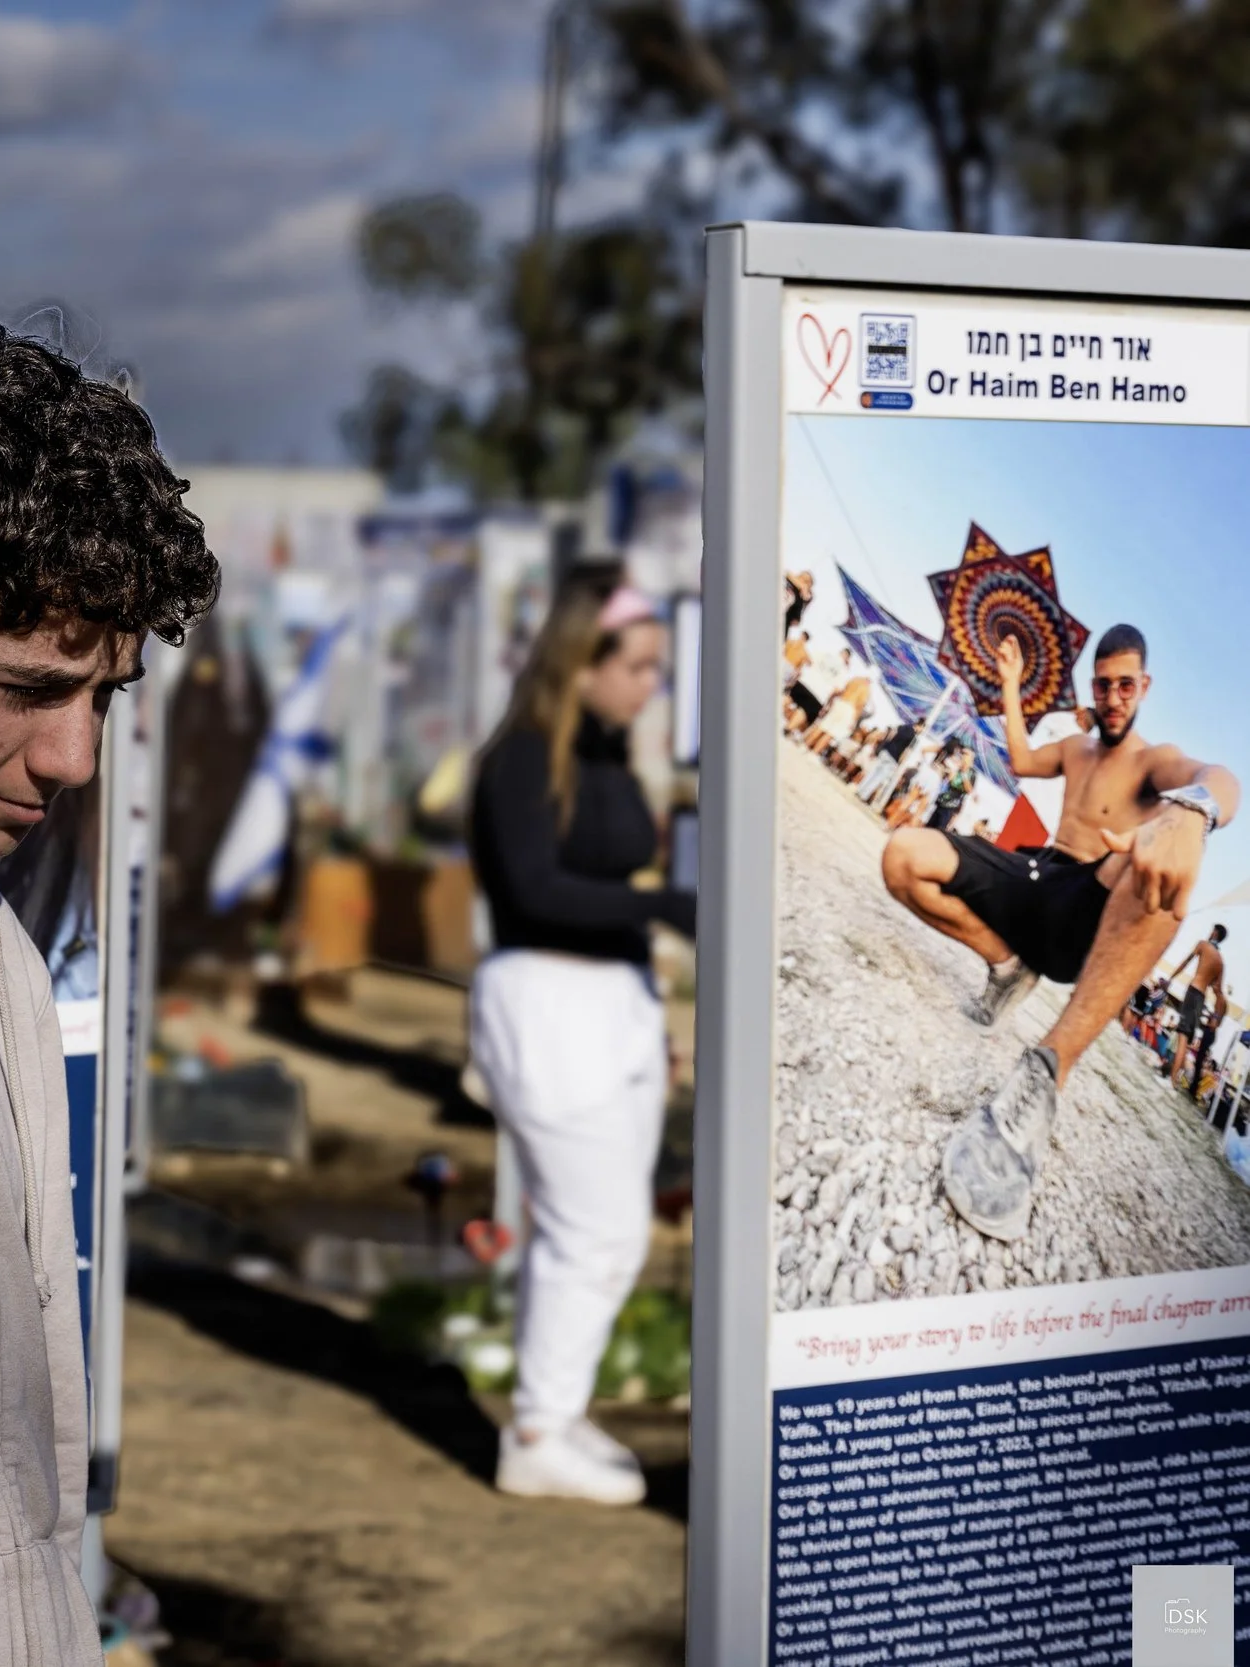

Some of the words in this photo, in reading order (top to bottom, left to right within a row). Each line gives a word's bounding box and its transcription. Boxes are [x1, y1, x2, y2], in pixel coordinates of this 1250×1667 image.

[968, 331, 1008, 355] חמו
[1020, 333, 1042, 361] בן
[1053, 335, 1101, 359] חיים
[1113, 337, 1150, 360] אור
[928, 370, 958, 395] Or
[970, 372, 1038, 397] Haim
[1051, 374, 1099, 400] Ben
[1112, 377, 1186, 403] Hamo
[866, 1333, 911, 1364] your
[917, 1327, 962, 1355] story
[967, 1323, 985, 1342] to
[991, 1309, 1018, 1350] life
[1023, 1306, 1073, 1346] before
[1080, 1301, 1104, 1329] the
[1103, 1295, 1151, 1338] final
[1153, 1293, 1217, 1329] chapter
[780, 1406, 801, 1420] He
[803, 1404, 833, 1418] was
[836, 1398, 854, 1414] 19
[856, 1397, 896, 1415] years
[898, 1391, 920, 1407] old
[922, 1390, 956, 1404] from
[958, 1382, 1017, 1400] Rehovot,
[1019, 1379, 1042, 1392] the
[1044, 1371, 1095, 1389] beloved
[1097, 1365, 1155, 1386] youngest
[1158, 1364, 1181, 1375] son
[1184, 1359, 1197, 1372] of
[779, 1441, 833, 1460] Rachel.
[835, 1438, 847, 1453] A
[849, 1436, 892, 1455] young
[894, 1429, 933, 1446] uncle
[935, 1426, 965, 1441] who
[967, 1418, 1015, 1437] adored
[1017, 1417, 1038, 1430] his
[1040, 1413, 1084, 1428] nieces
[1086, 1407, 1111, 1422] and
[1113, 1402, 1173, 1419] nephews.
[779, 1465, 797, 1480] Or
[799, 1463, 829, 1477] was
[832, 1452, 899, 1473] murdered
[902, 1452, 920, 1464] on
[922, 1444, 978, 1462] October
[980, 1440, 994, 1456] 7,
[996, 1436, 1034, 1452] 2023,
[1036, 1434, 1050, 1447] at
[1053, 1432, 1075, 1445] the
[1138, 1420, 1175, 1434] Curve
[1178, 1414, 1212, 1428] while
[824, 1420, 852, 1435] The
[854, 1414, 907, 1432] brother
[908, 1410, 924, 1425] of
[778, 1482, 830, 1500] escape
[833, 1476, 865, 1492] with
[867, 1473, 889, 1488] his
[891, 1467, 940, 1485] friends
[942, 1464, 974, 1478] from
[977, 1460, 1000, 1474] the
[1003, 1457, 1037, 1470] Nova
[1039, 1448, 1091, 1466] festival.
[778, 1504, 805, 1519] Our
[807, 1500, 826, 1515] Or
[828, 1498, 857, 1512] was
[860, 1496, 878, 1508] an
[961, 1484, 971, 1495] a
[973, 1480, 1001, 1494] free
[1004, 1474, 1042, 1492] spirit.
[1046, 1470, 1064, 1484] He
[1066, 1464, 1101, 1480] loved
[1104, 1464, 1118, 1476] to
[1163, 1454, 1188, 1467] ride
[1191, 1452, 1210, 1463] his
[778, 1522, 805, 1539] and
[808, 1520, 827, 1535] sit
[830, 1518, 844, 1532] in
[846, 1516, 876, 1530] awe
[878, 1510, 894, 1525] of
[896, 1506, 950, 1523] endless
[953, 1496, 1030, 1515] landscapes
[1032, 1491, 1063, 1504] from
[1065, 1482, 1114, 1500] lookout
[1116, 1478, 1156, 1496] points
[1158, 1472, 1200, 1487] across
[1203, 1468, 1224, 1480] the
[777, 1561, 810, 1578] With
[813, 1560, 832, 1573] an
[834, 1555, 869, 1572] open
[872, 1548, 914, 1565] heart,
[916, 1546, 934, 1558] he
[937, 1536, 997, 1556] dreamed
[1000, 1532, 1014, 1547] of
[1017, 1534, 1026, 1544] a
[1028, 1529, 1050, 1542] life
[1052, 1523, 1086, 1539] filled
[1088, 1520, 1116, 1534] with
[1225, 1500, 1248, 1514] and
[778, 1544, 798, 1558] He
[801, 1536, 851, 1555] thrived
[853, 1536, 872, 1548] on
[874, 1531, 898, 1545] the
[900, 1526, 948, 1542] energy
[951, 1520, 966, 1535] of
[968, 1517, 1013, 1532] nature
[1097, 1498, 1153, 1514] freedom,
[1156, 1493, 1177, 1506] the
[1179, 1492, 1201, 1506] joy,
[1204, 1486, 1224, 1498] the
[777, 1580, 827, 1598] always
[830, 1570, 899, 1590] searching
[901, 1566, 921, 1580] for
[924, 1564, 945, 1577] his
[948, 1558, 982, 1576] path.
[986, 1554, 1005, 1568] He
[1007, 1550, 1030, 1565] felt
[1033, 1544, 1077, 1561] deeply
[1079, 1533, 1146, 1554] connected
[1149, 1532, 1162, 1544] to
[1165, 1530, 1184, 1541] his
[777, 1599, 832, 1617] seeking
[835, 1596, 851, 1609] to
[853, 1592, 889, 1610] grow
[892, 1580, 963, 1602] spiritually,
[966, 1570, 1037, 1590] embracing
[1040, 1567, 1059, 1579] his
[1062, 1559, 1116, 1575] heritage
[1119, 1552, 1146, 1566] with
[1150, 1550, 1175, 1561] love
[1178, 1544, 1201, 1557] and
